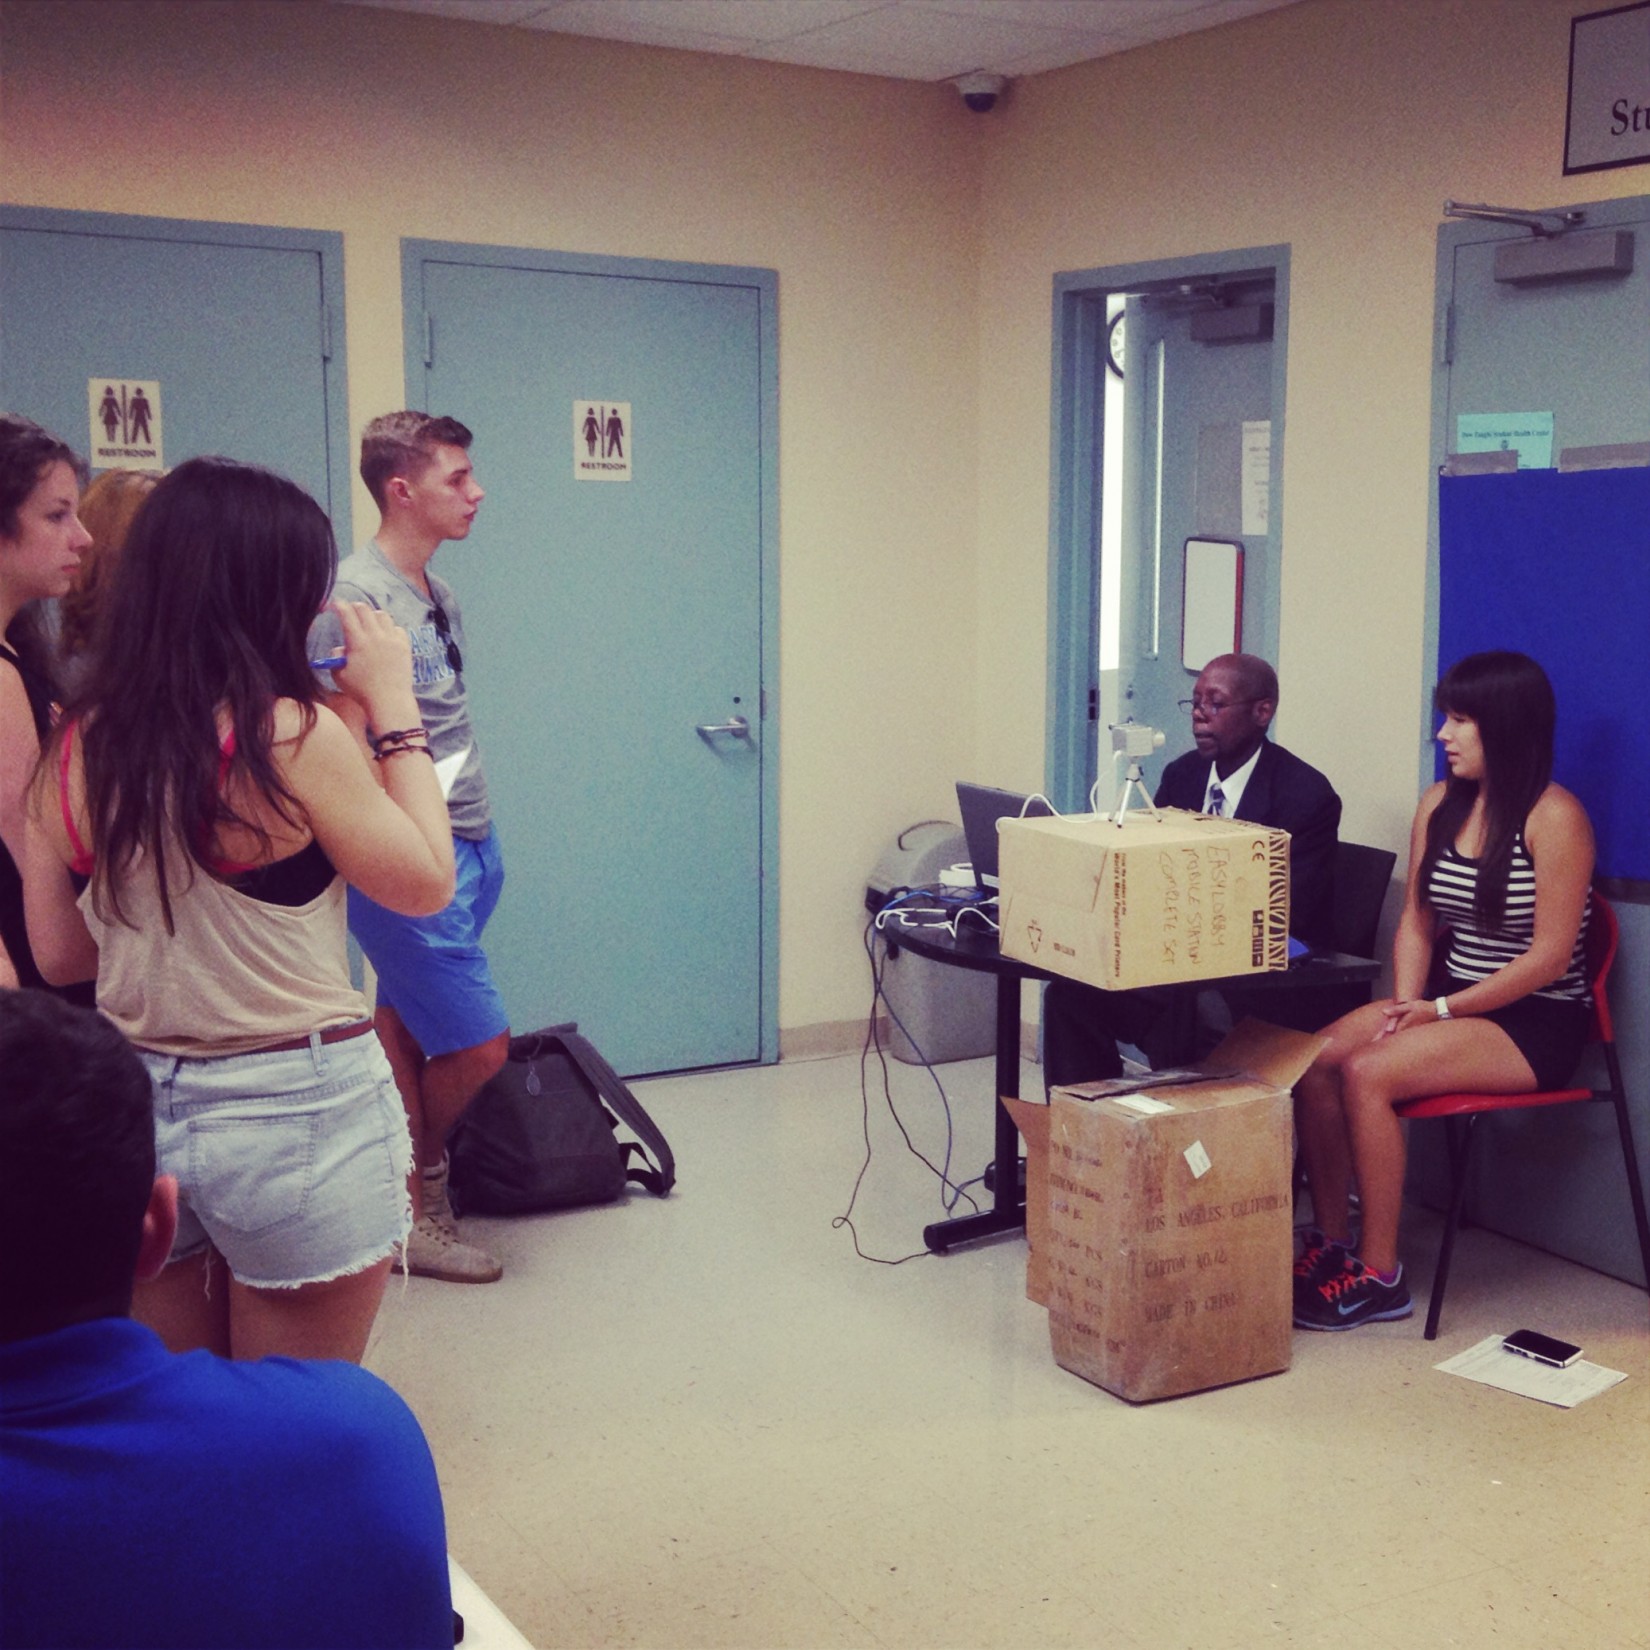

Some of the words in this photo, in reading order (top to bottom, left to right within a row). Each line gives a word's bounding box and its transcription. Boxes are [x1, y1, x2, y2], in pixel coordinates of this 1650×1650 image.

[98, 448, 156, 458] RESTROOM
[581, 462, 627, 470] RESTROOM
[1181, 848, 1201, 906] MOBILE
[1159, 851, 1179, 932] COMPLETE
[1112, 902, 1121, 929] Popular
